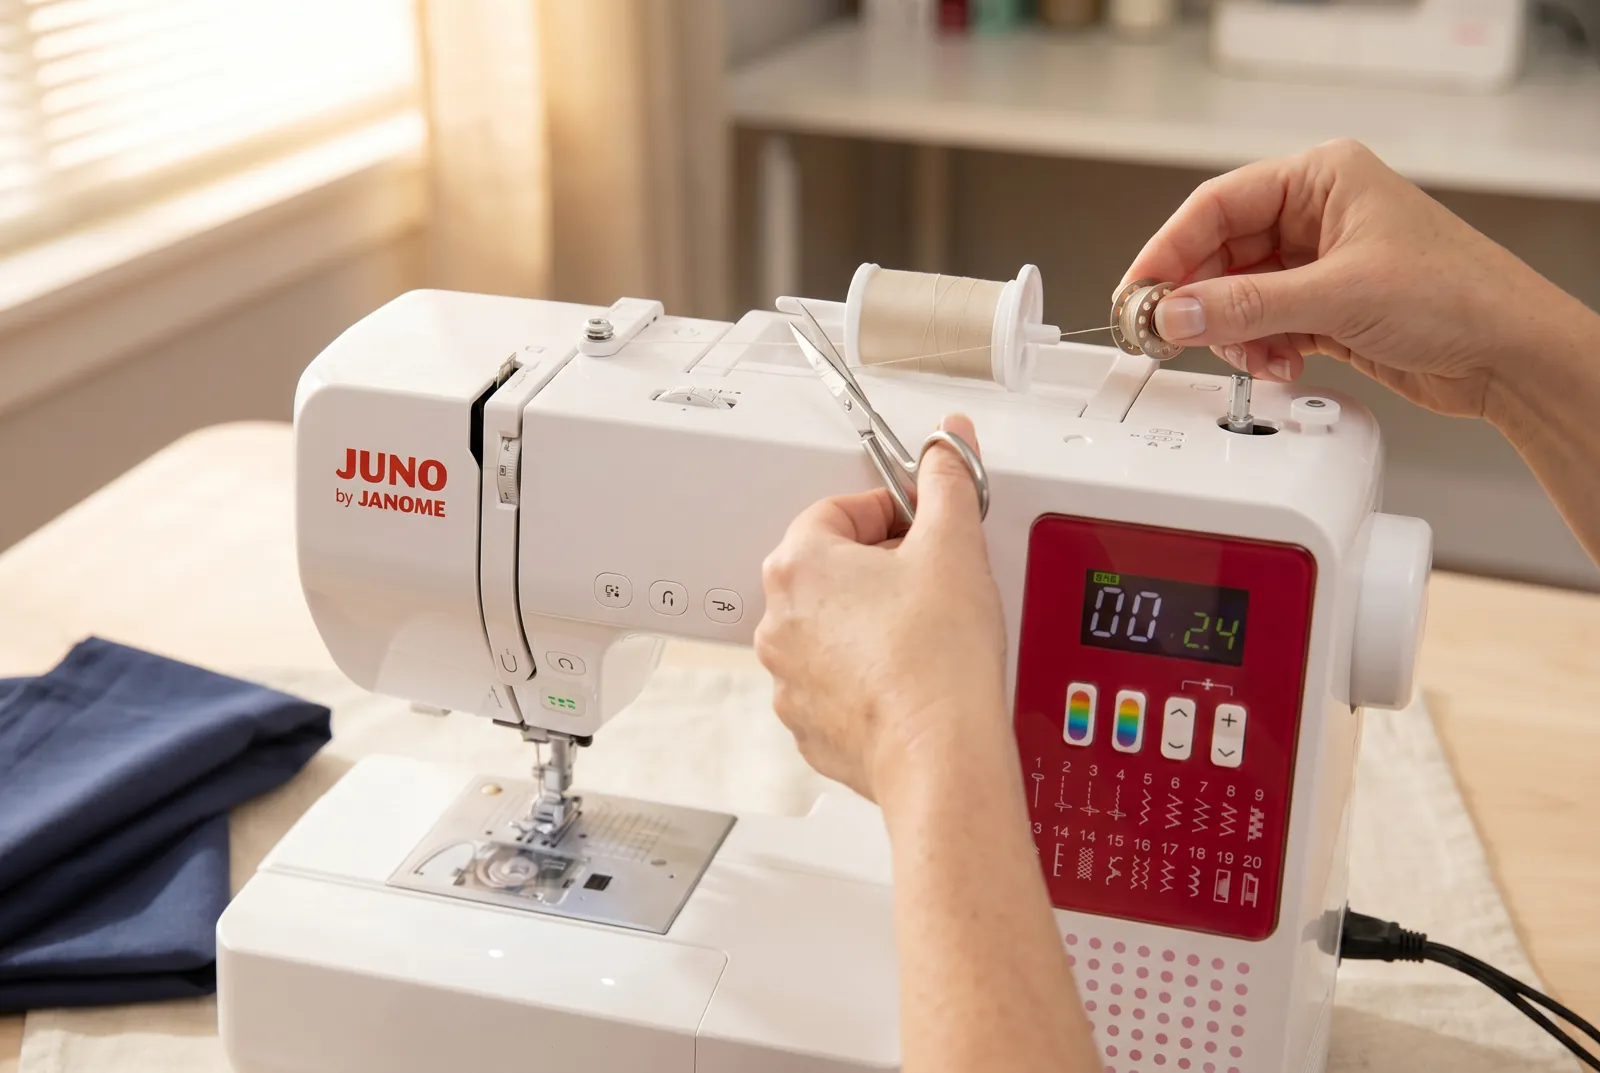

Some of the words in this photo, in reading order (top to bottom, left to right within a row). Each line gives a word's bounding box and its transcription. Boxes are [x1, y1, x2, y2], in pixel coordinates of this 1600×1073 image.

[336, 448, 447, 491] JUNO
[336, 488, 353, 507] by
[358, 490, 446, 518] JANOME
[1090, 586, 1162, 642] 00
[1035, 757, 1041, 768] 1
[1062, 761, 1071, 773] 2
[1089, 765, 1098, 776] 3
[1116, 769, 1125, 781] 4
[1143, 773, 1152, 785] 5
[1170, 777, 1180, 789] 6
[1199, 781, 1209, 793] 7
[1226, 785, 1236, 797] 8
[1255, 789, 1264, 801] 9
[1053, 825, 1070, 838] 14
[1080, 830, 1096, 842] 14
[1107, 834, 1124, 847] 15
[1134, 838, 1151, 851] 16
[1162, 843, 1179, 855] 17
[1189, 847, 1206, 860] 18
[1217, 851, 1234, 864] 19
[1243, 855, 1262, 869] 20
